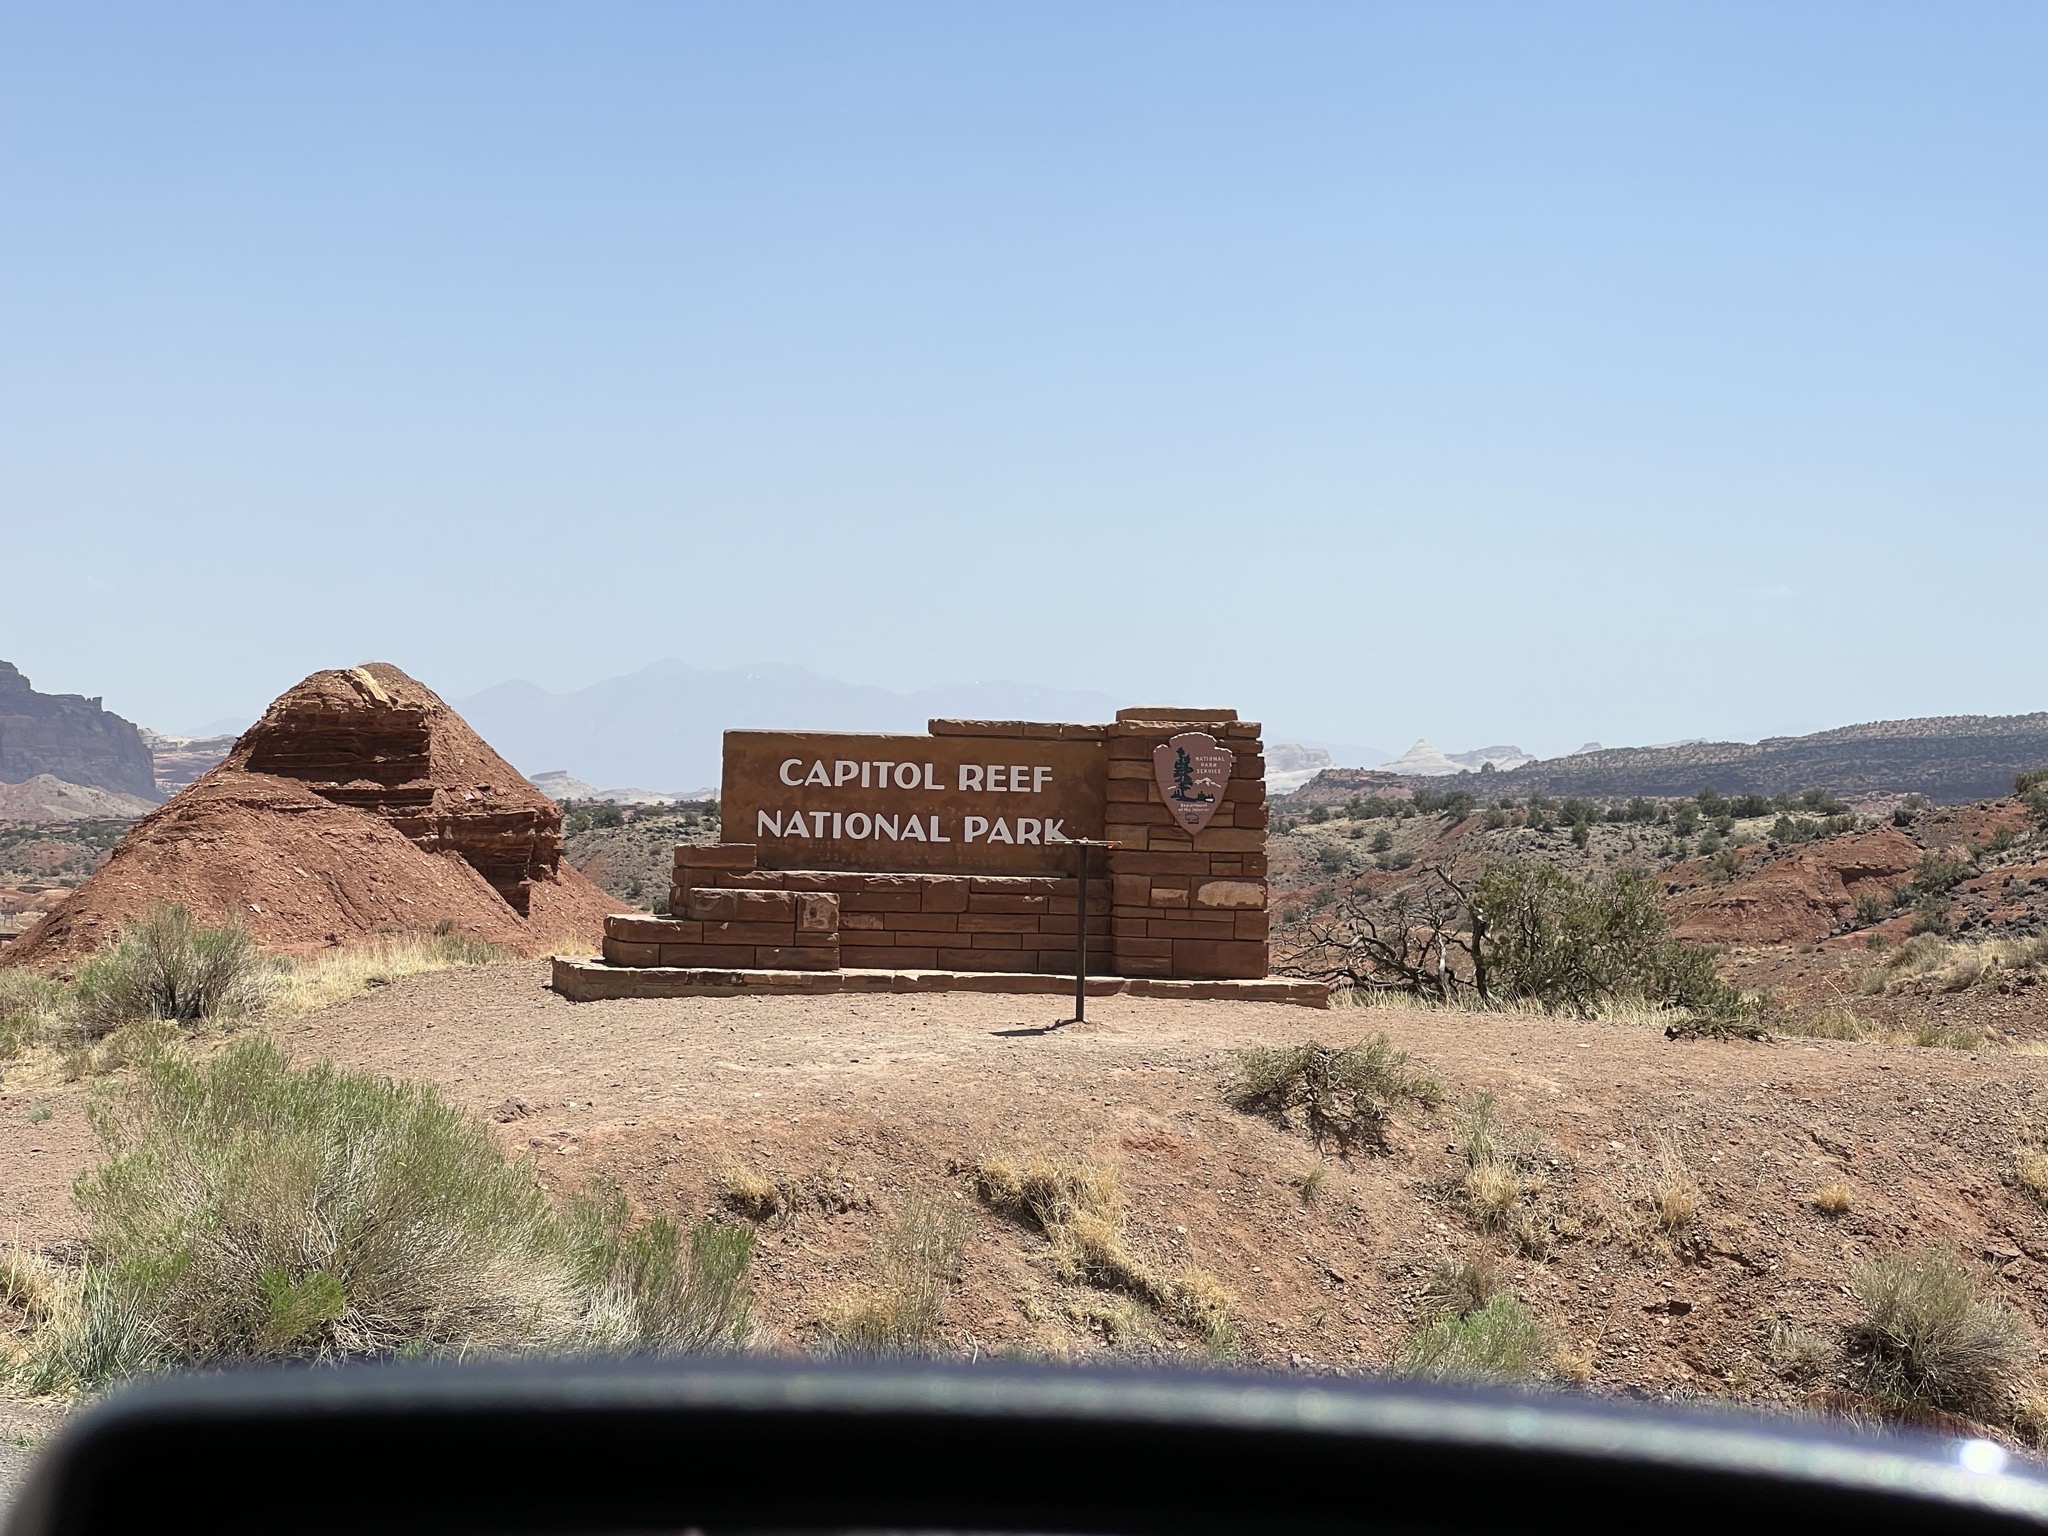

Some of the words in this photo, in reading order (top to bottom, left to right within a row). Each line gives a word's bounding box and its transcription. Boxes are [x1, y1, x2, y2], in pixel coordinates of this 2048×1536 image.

[779, 758, 945, 790] CAPITOL
[958, 764, 1053, 792] REEF
[757, 810, 951, 843] NATIONAL
[964, 816, 1069, 845] PARK
